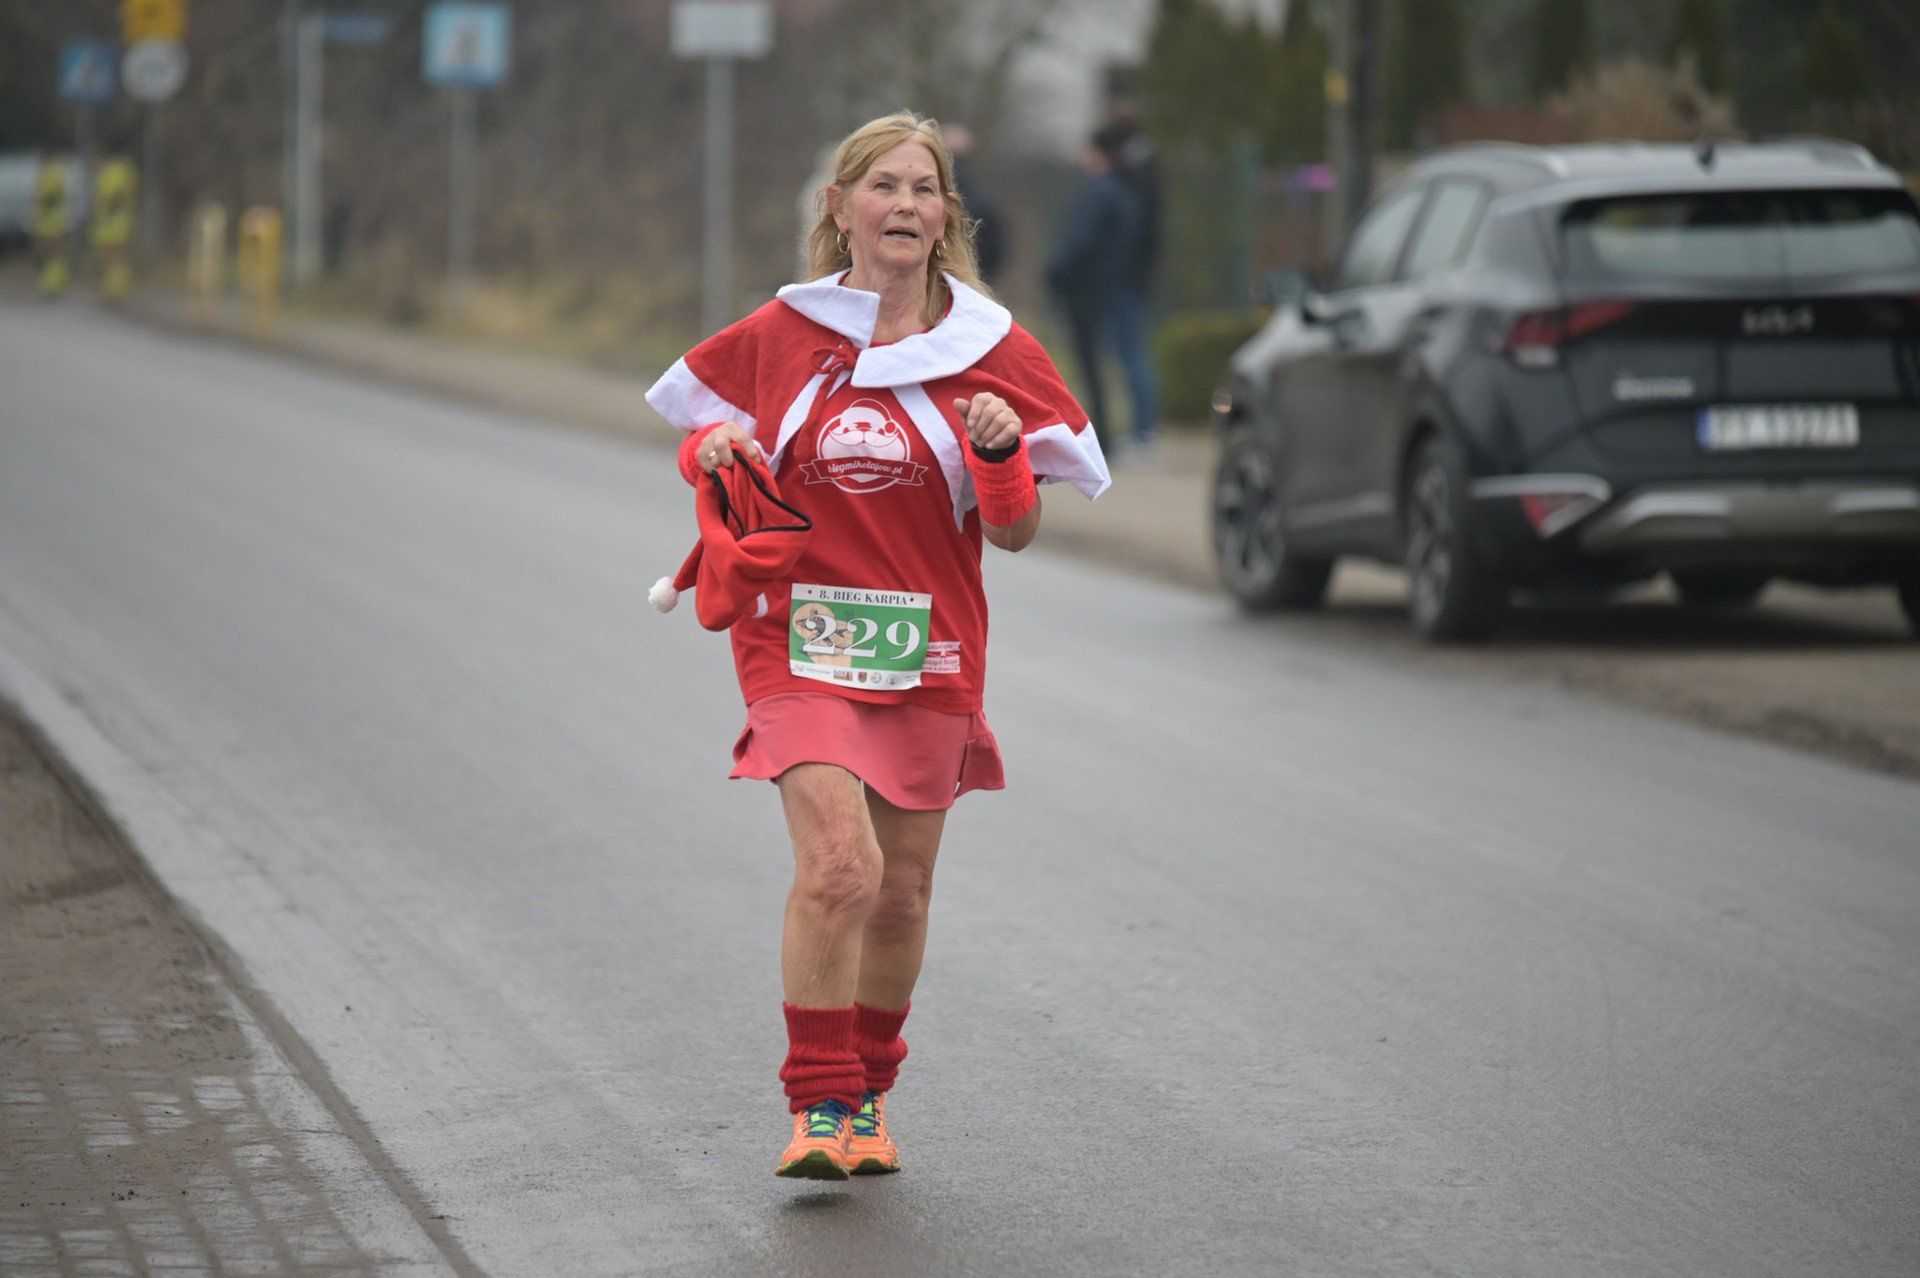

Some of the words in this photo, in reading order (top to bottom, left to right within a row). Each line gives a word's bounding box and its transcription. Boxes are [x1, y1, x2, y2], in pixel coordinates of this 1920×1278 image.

[819, 589, 829, 600] 8.
[833, 591, 861, 602] BIEG
[865, 593, 907, 605] KARPIA
[802, 614, 921, 660] 229
